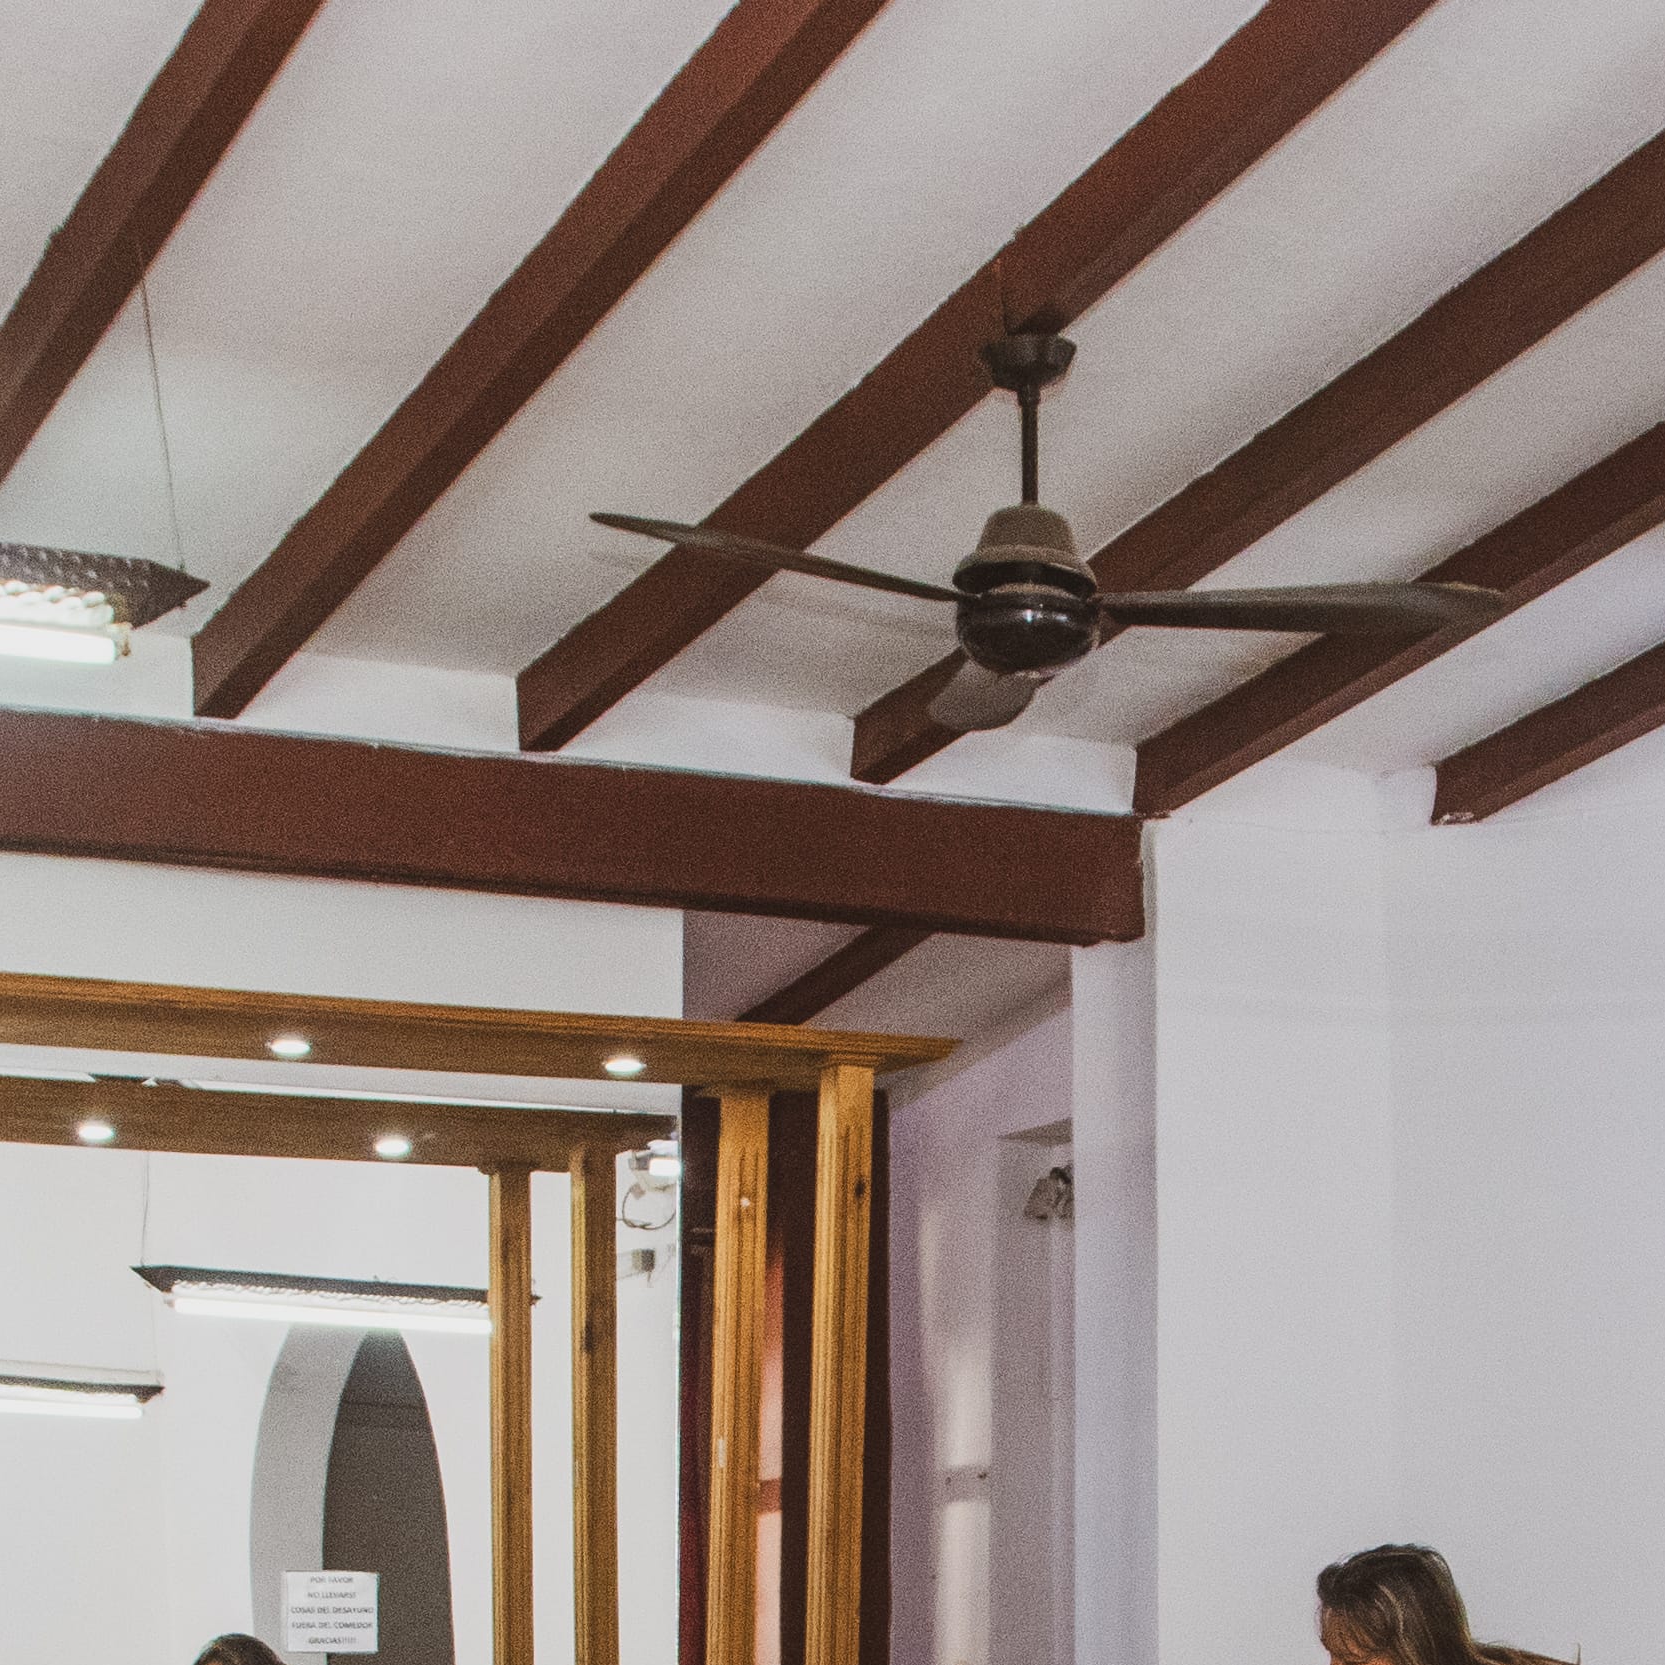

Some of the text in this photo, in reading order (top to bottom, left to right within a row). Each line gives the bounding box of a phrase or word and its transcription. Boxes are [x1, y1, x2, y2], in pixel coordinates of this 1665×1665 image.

[311, 1576, 354, 1584] POR FAVOR
[308, 1591, 356, 1600] NO LLEVARSE
[291, 1606, 374, 1614] COSAS DEL DESAYUNO
[292, 1621, 373, 1630] FUERA DEL COMEDOR
